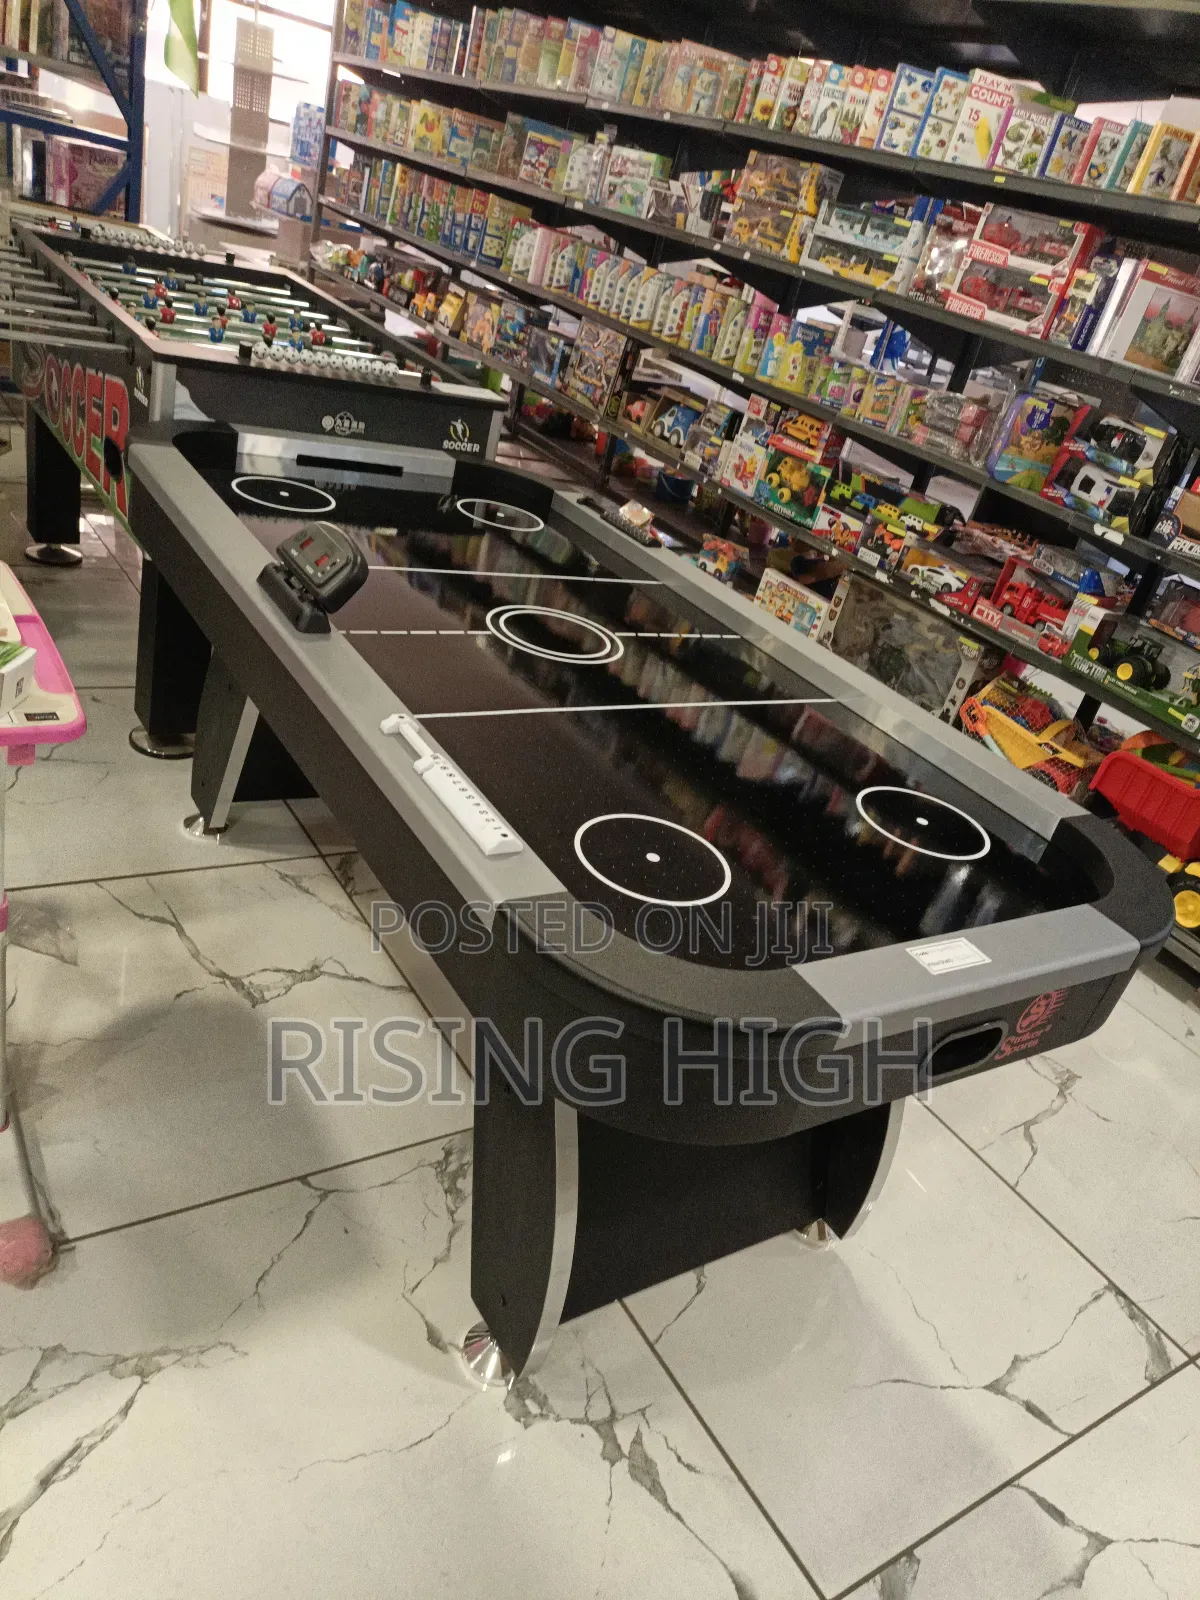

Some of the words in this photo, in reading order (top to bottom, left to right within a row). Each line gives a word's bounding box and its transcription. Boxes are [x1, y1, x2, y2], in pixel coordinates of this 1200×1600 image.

[979, 76, 1000, 89] PLAY
[970, 87, 1011, 107] COUNT
[968, 107, 981, 121] 15
[21, 342, 130, 523] SOCCER
[443, 440, 480, 452] SOCCER
[972, 604, 1001, 629] CITY
[1070, 654, 1108, 682] TRACTOR
